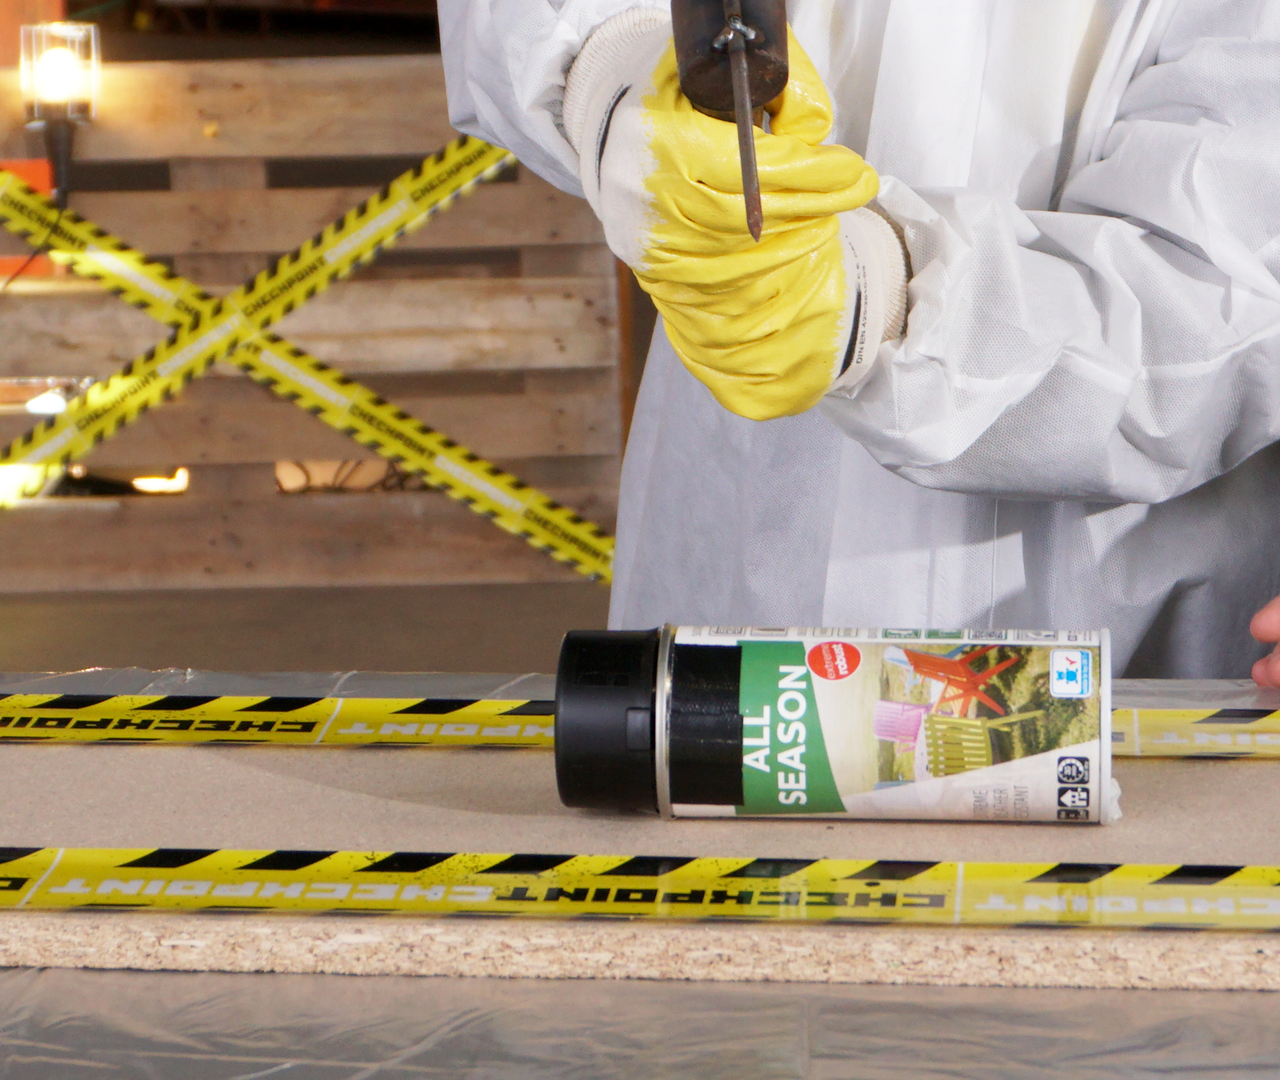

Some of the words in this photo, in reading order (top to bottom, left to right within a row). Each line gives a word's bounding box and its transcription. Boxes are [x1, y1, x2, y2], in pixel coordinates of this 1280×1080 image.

[240, 255, 327, 318] CHECKPOINT
[821, 644, 836, 680] extreme
[832, 643, 849, 676] robust
[336, 721, 555, 737] KPOINT
[742, 705, 770, 773] ALL
[777, 665, 807, 805] SEASON
[48, 877, 494, 903] CHECKPOINT
[495, 886, 946, 908] CHECKPOINT
